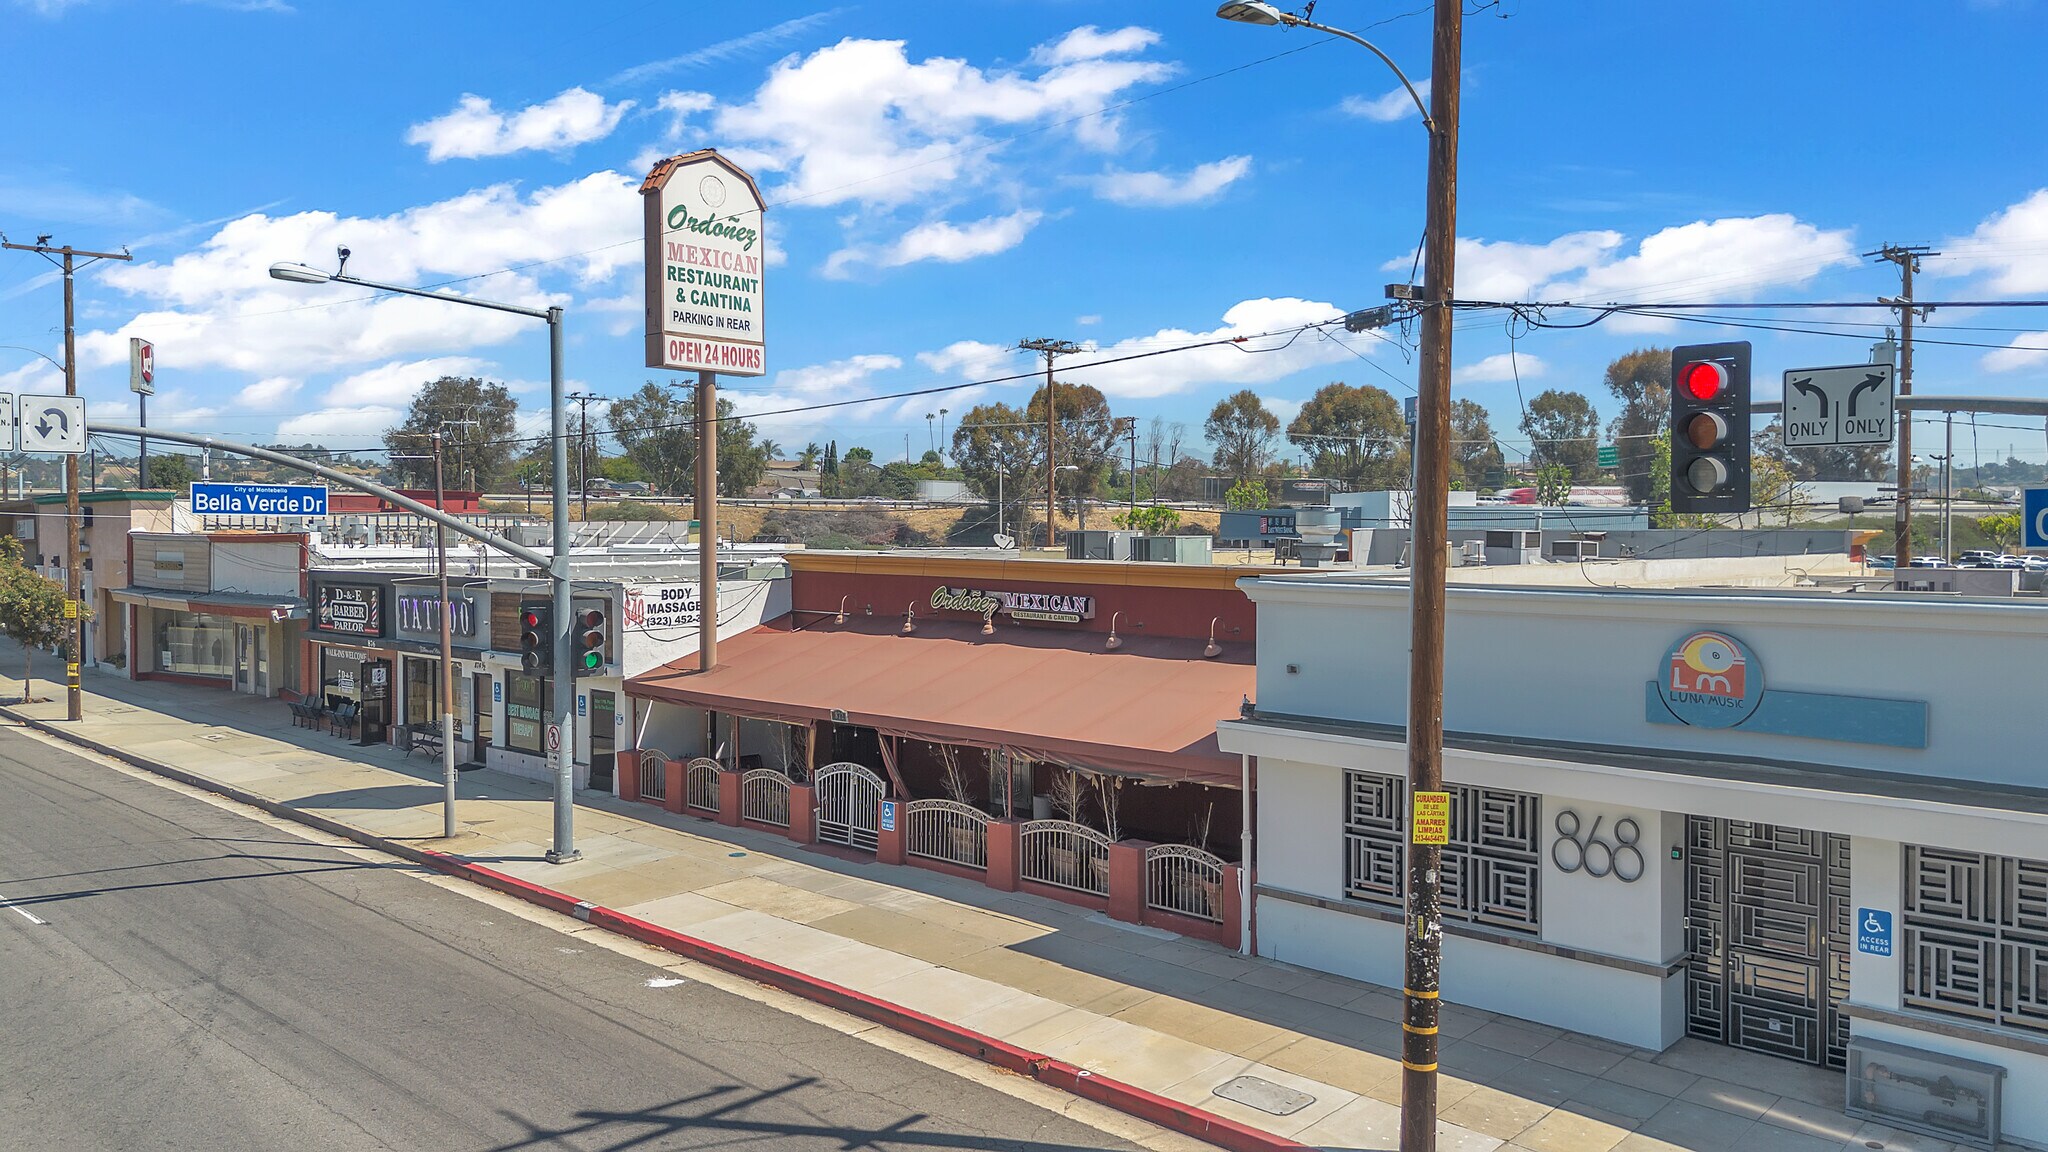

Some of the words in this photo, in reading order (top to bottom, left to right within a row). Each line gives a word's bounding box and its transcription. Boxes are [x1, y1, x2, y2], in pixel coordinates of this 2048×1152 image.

[667, 204, 757, 251] Ordoñez
[667, 241, 758, 275] MEXICAN
[667, 265, 758, 293] RESTAURANT
[676, 287, 686, 303] &
[690, 290, 751, 312] CANTINA
[673, 310, 713, 326] PARKING
[716, 316, 724, 328] IN
[727, 318, 750, 331] REAR
[670, 340, 701, 363] OPEN
[705, 344, 719, 365] 24
[722, 346, 760, 369] HOURS
[1790, 421, 1828, 436] ONLY
[1845, 419, 1885, 435] ONLY
[256, 486, 288, 494] Montebello
[195, 493, 241, 511] Bella
[246, 494, 299, 512] Verde
[303, 496, 323, 512] Dr
[661, 587, 692, 600] BODY
[647, 601, 701, 614] MASSAGE
[931, 586, 998, 620] Ordoñez
[1005, 592, 1086, 613] MEXICAN
[334, 605, 364, 618] BARBER
[1013, 611, 1047, 620] RESTAURANT
[1053, 614, 1078, 622] CANTINA
[334, 621, 364, 632] PARLOR
[646, 616, 672, 628] (323)
[1669, 691, 1704, 704] LUNA
[1708, 696, 1744, 709] MUSIC
[1416, 795, 1446, 803] CURANDERA
[1551, 810, 1645, 883] 868
[1860, 936, 1889, 946] ACCESS
[1870, 944, 1889, 954] REAR
